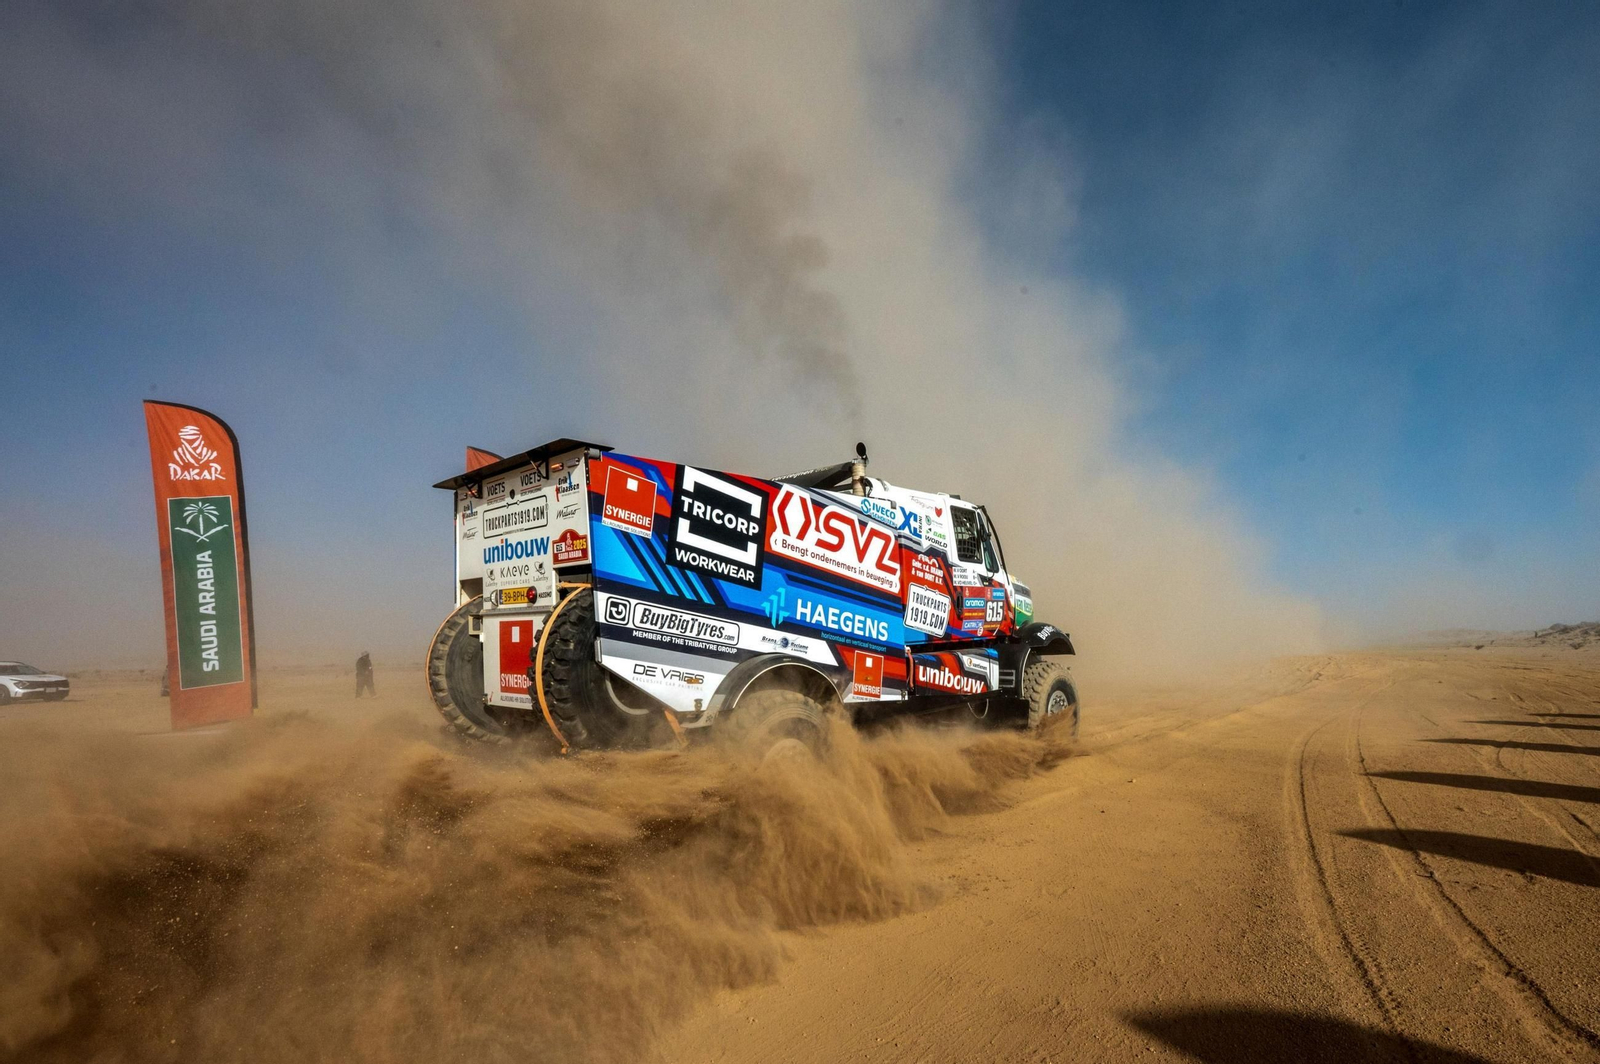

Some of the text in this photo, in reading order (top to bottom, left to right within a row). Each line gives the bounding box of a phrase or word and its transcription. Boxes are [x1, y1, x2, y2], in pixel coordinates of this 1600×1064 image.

[168, 462, 226, 480] DAKAR
[520, 472, 542, 486] VOETS
[486, 482, 506, 497] VOETS
[486, 506, 545, 532] TRUCKPARTS1919.COM
[606, 504, 652, 528] SYNERGIE
[681, 495, 760, 536] TRICORP
[872, 502, 896, 520] IVECO
[898, 506, 922, 539] XL
[484, 536, 550, 564] unibouw
[574, 538, 586, 550] 2025
[815, 511, 898, 576] SVZ
[924, 535, 948, 548] WORLD
[675, 548, 754, 582] WORKWEAR
[782, 540, 894, 588] Brengt ondernemers in beweging
[197, 550, 219, 671] SAUDI ARABIA
[912, 592, 947, 614] TRUCKPARTS
[986, 602, 1004, 622] 615
[796, 598, 888, 642] HAEGENS
[910, 606, 946, 630] 1919.COM
[632, 630, 738, 654] MEMBER OF THE TRIBATYRE GROUP
[821, 631, 846, 644] horizontaal
[868, 642, 886, 652] transport
[632, 676, 662, 685] EXCLUSIVE
[633, 664, 704, 684] DE VRIES
[919, 666, 984, 694] unibouw
[854, 682, 881, 696] SYNERGIE
